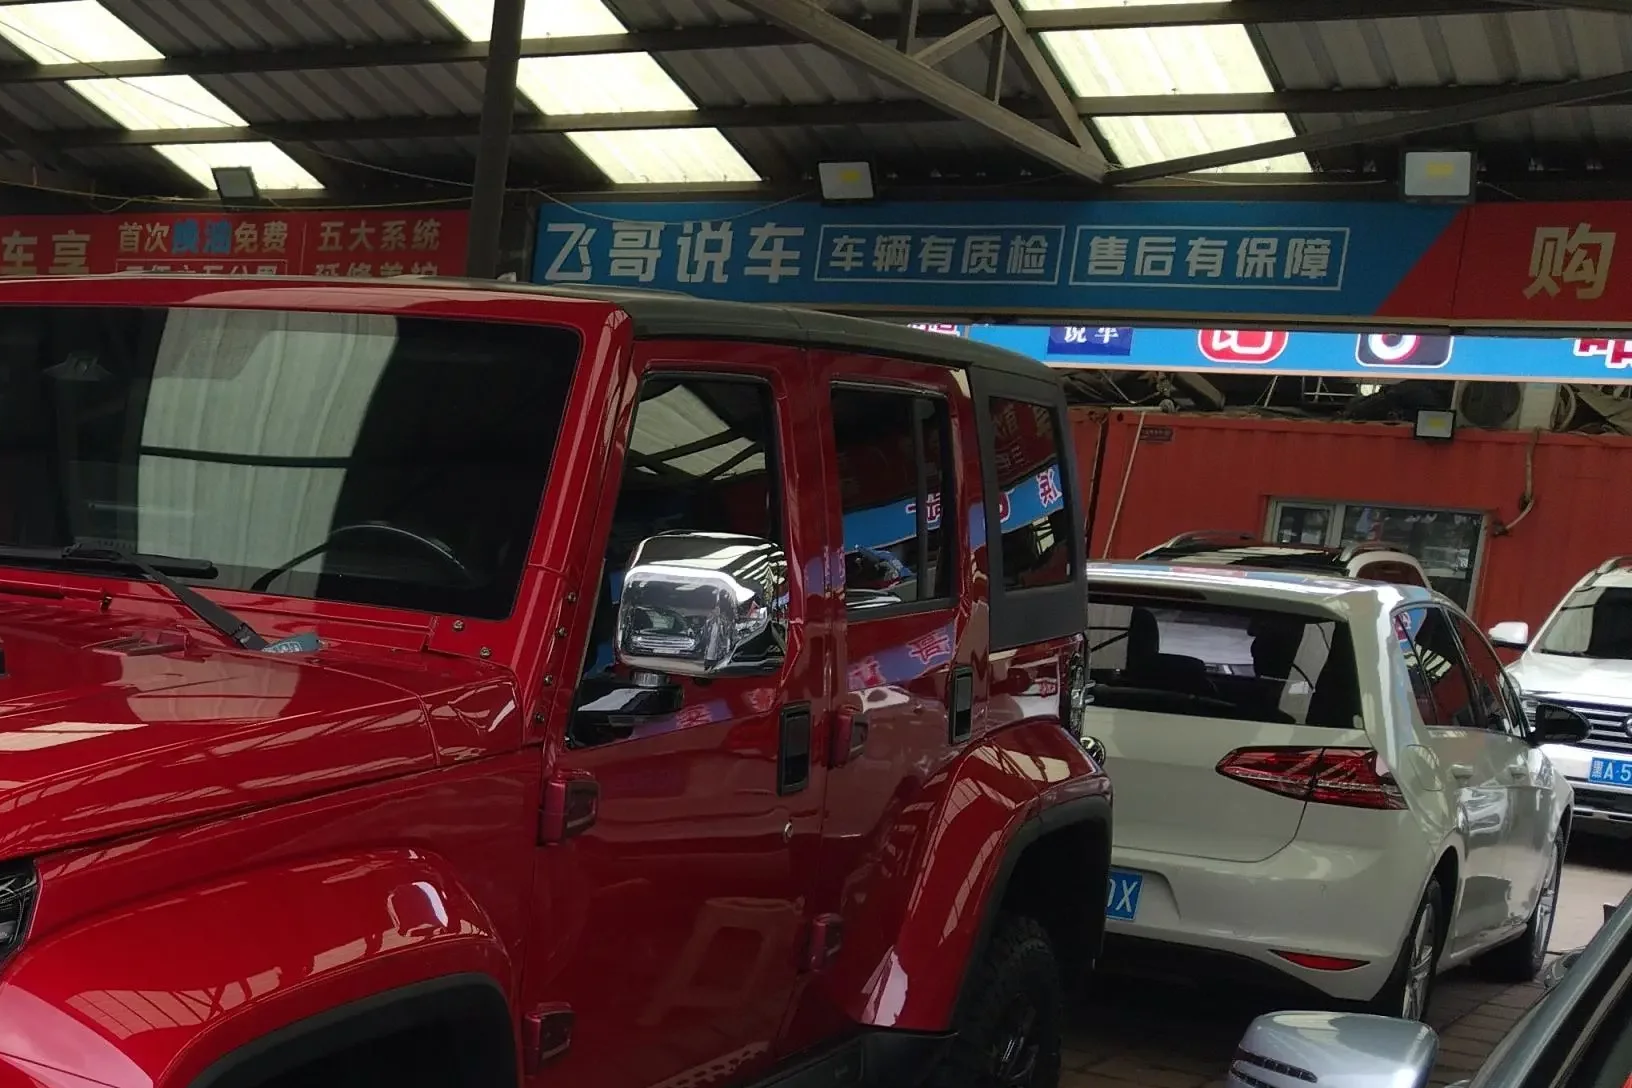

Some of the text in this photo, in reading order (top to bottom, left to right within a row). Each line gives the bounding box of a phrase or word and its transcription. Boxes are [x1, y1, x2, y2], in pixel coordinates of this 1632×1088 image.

[320, 219, 442, 252] 五大系统
[545, 221, 806, 284] 飞哥说车
[829, 233, 1048, 276] 车辆有质检
[1088, 236, 1332, 280] 售后有保障
[1522, 222, 1616, 299] 购
